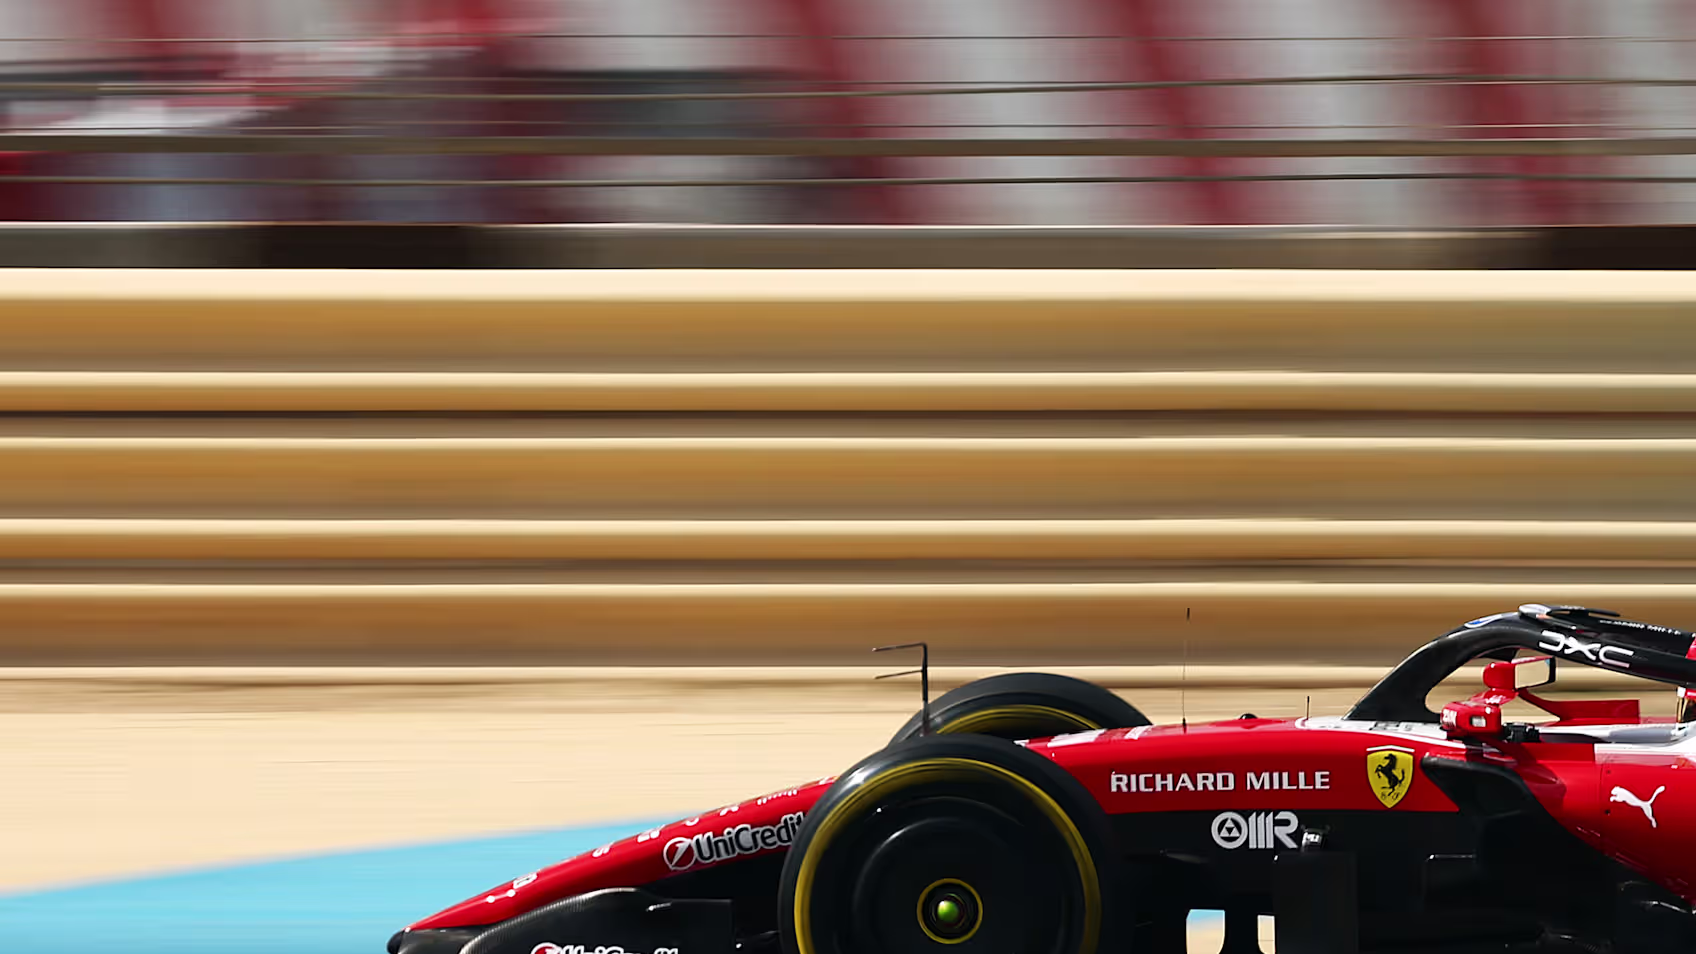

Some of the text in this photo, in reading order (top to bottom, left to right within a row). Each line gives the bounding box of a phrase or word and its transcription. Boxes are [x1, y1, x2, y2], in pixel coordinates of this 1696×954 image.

[1538, 629, 1635, 669] DXC
[1110, 770, 1330, 793] RICHARD MILLE
